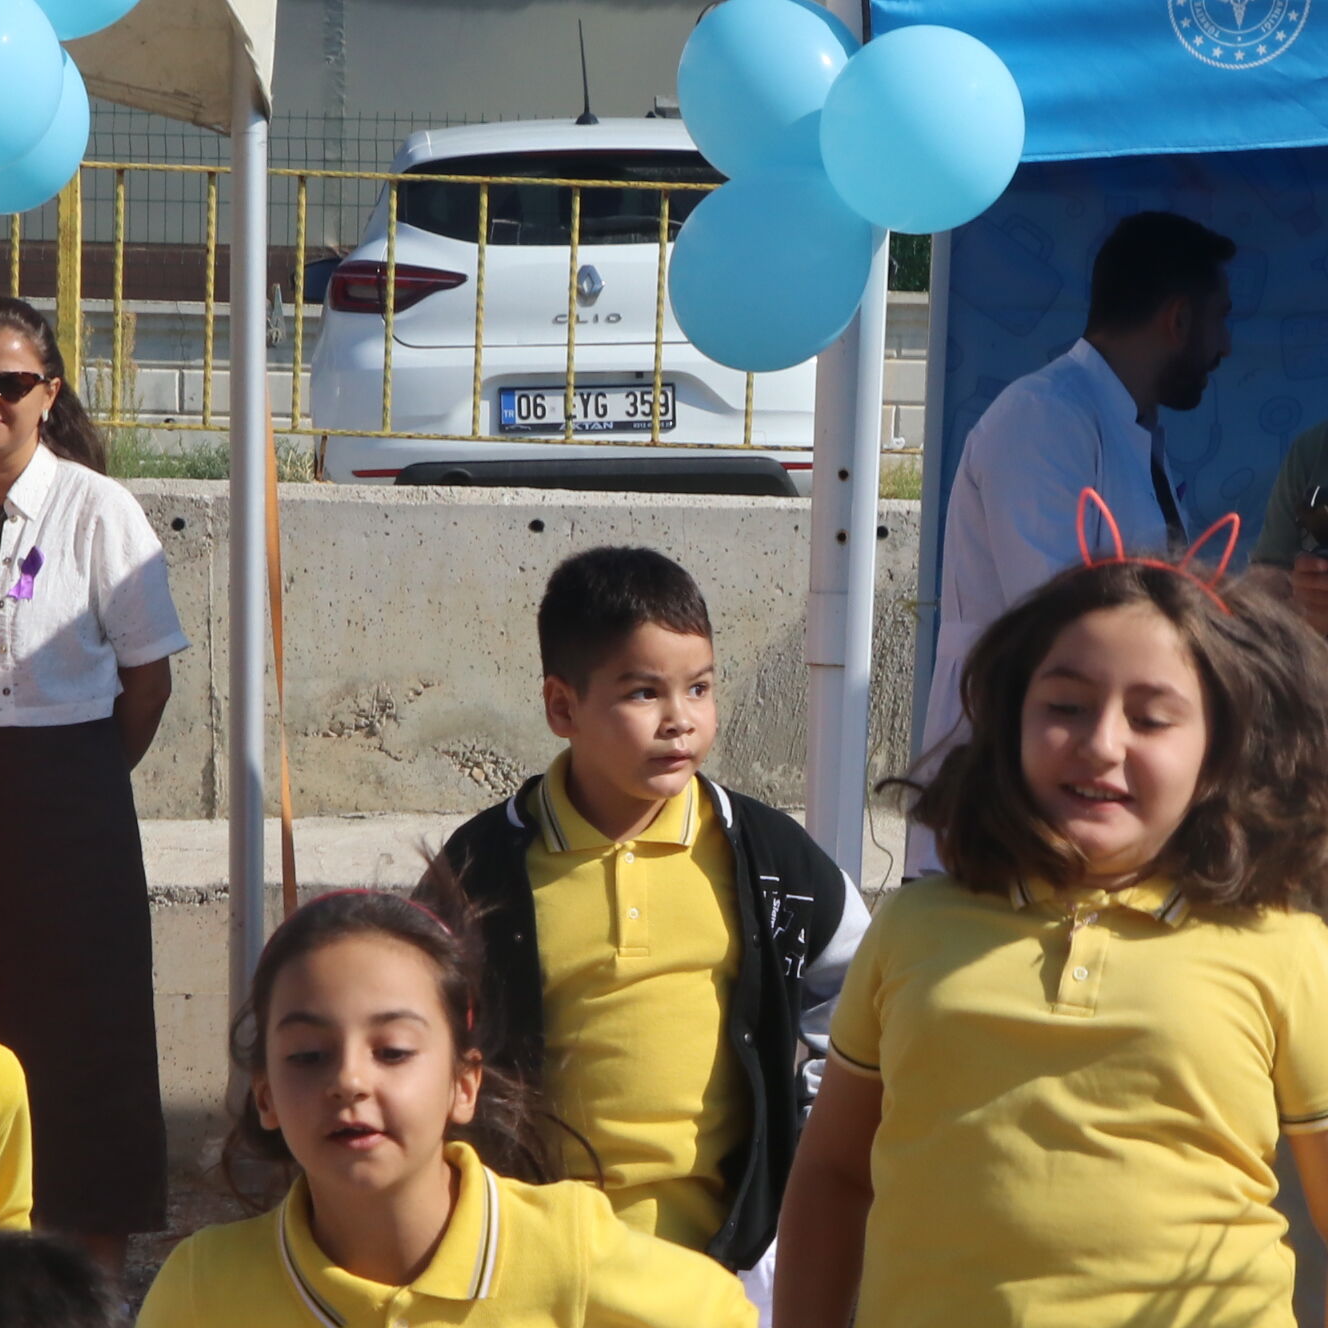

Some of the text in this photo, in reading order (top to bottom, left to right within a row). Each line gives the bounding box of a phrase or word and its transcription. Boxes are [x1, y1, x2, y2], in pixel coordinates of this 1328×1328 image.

[552, 313, 622, 324] CLIO
[517, 393, 547, 421] 06
[625, 390, 670, 418] 359
